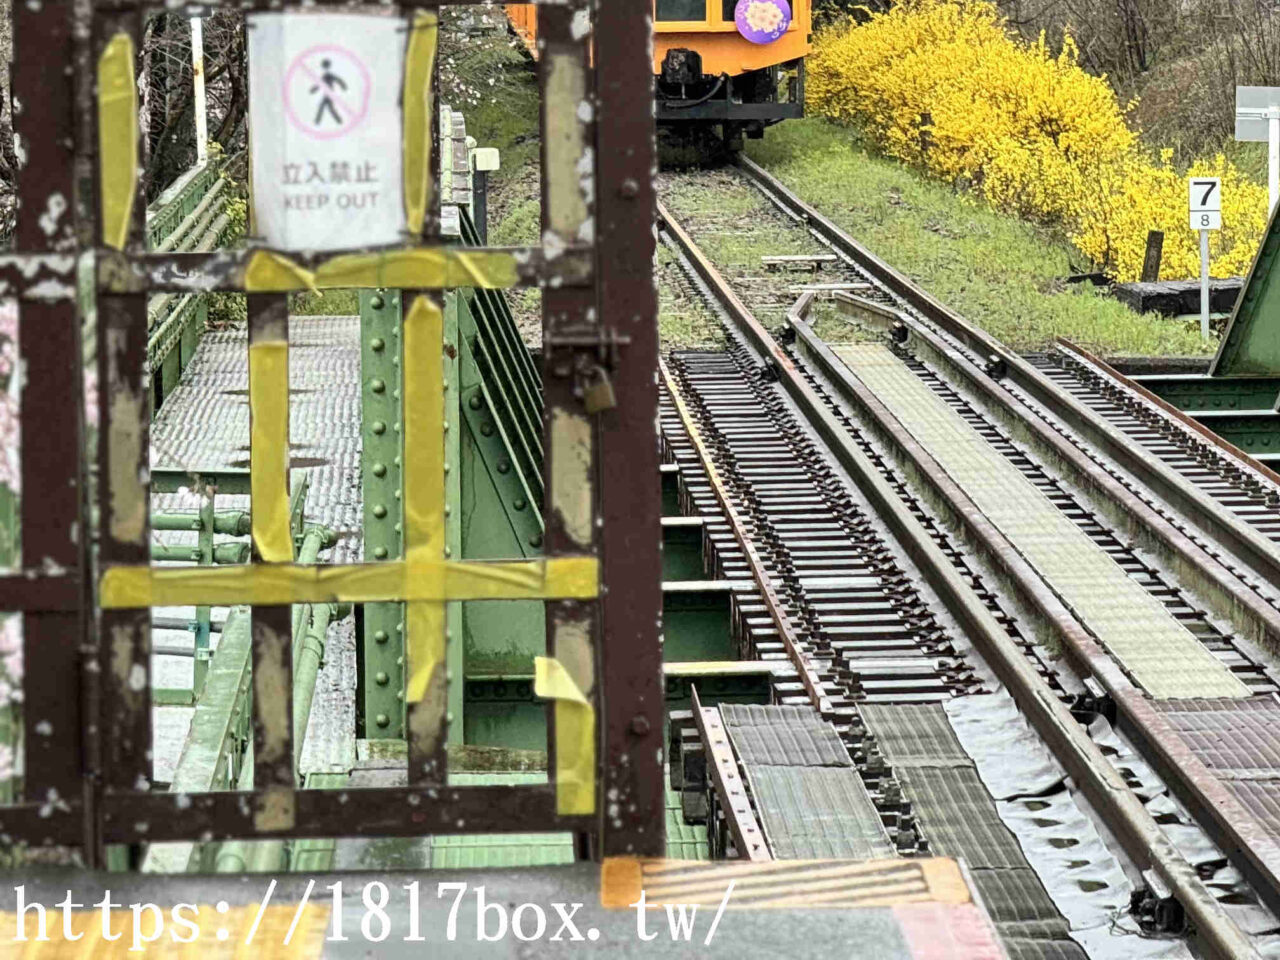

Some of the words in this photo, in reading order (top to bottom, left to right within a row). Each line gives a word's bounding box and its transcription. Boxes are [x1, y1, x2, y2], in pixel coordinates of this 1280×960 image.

[282, 161, 379, 185] 立入禁止
[284, 193, 330, 211] KEEP
[336, 192, 379, 209] OUT
[1192, 181, 1217, 206] 7
[1200, 214, 1210, 227] 8
